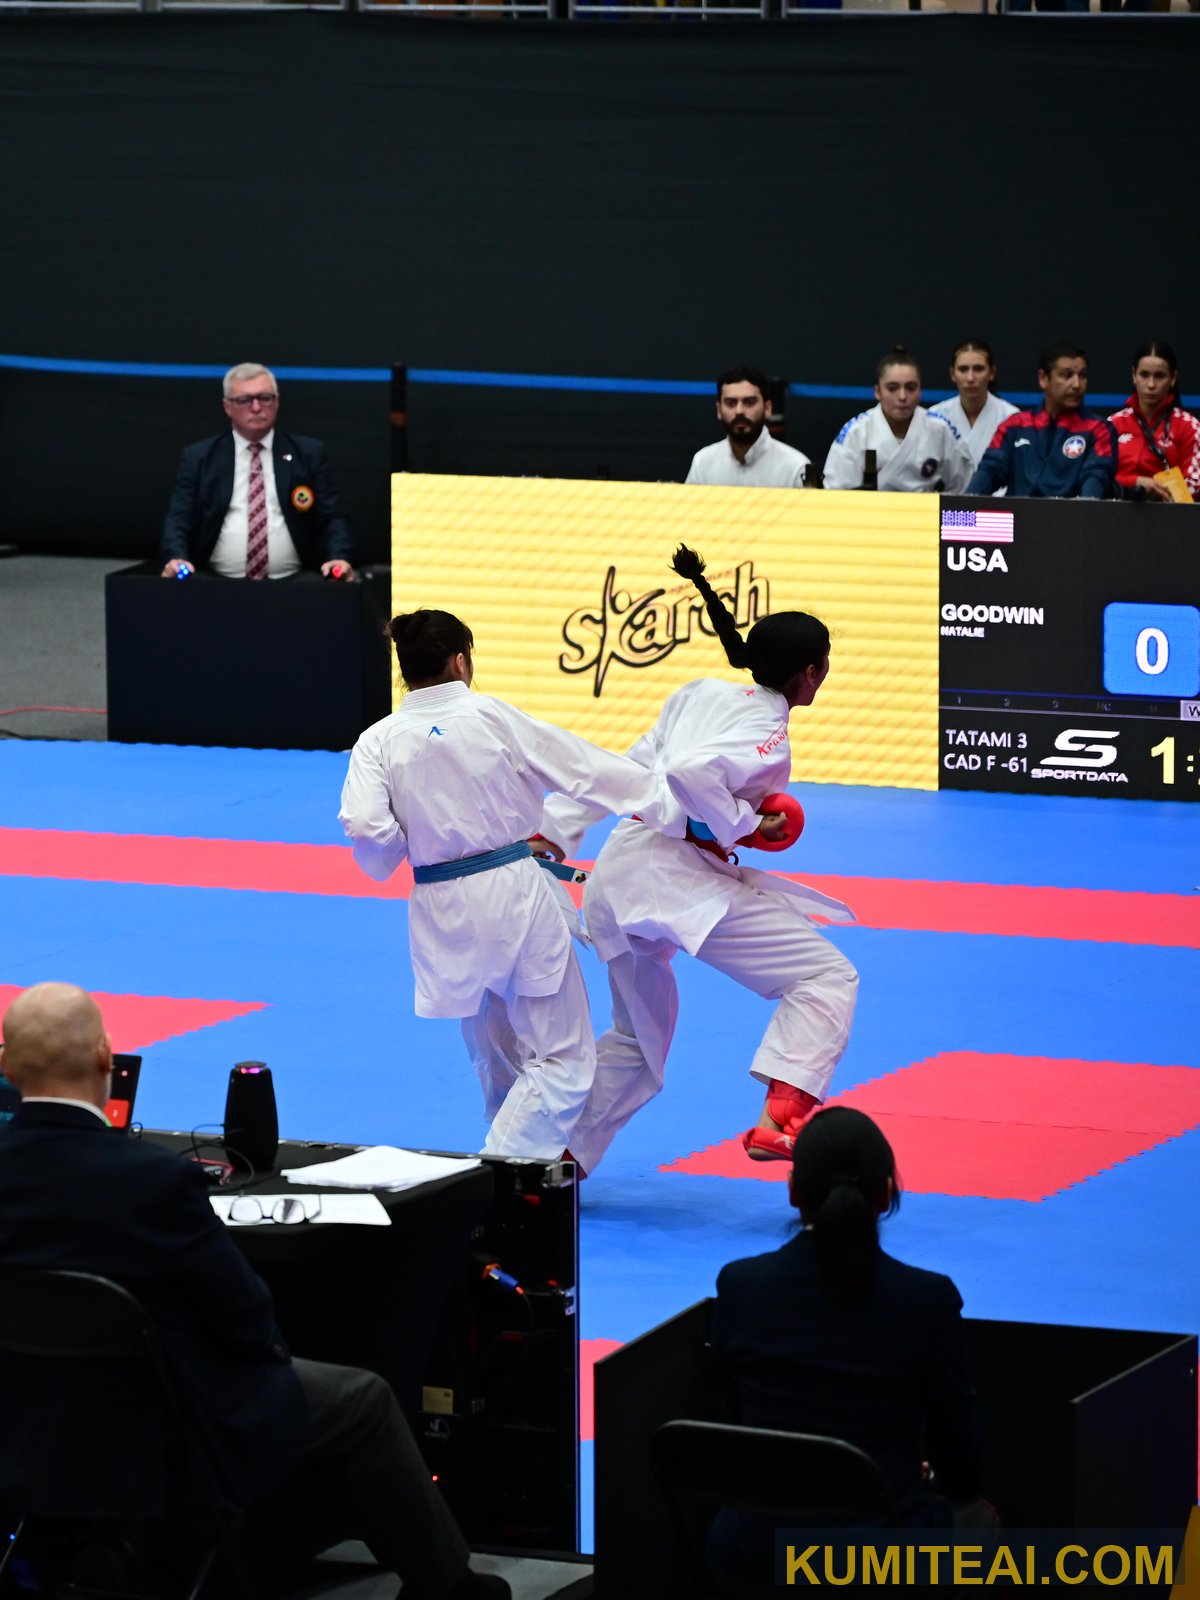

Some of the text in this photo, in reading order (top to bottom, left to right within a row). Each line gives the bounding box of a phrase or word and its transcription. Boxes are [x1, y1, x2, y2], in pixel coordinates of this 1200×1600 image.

[946, 546, 1009, 573] USA
[941, 603, 1044, 625] GOODWIN
[940, 626, 985, 638] NATALIE
[1135, 627, 1169, 675] 0
[945, 728, 1028, 749] TATAMI 3
[943, 752, 1028, 773] CAD F -61
[1030, 768, 1129, 783] SPORTDATA
